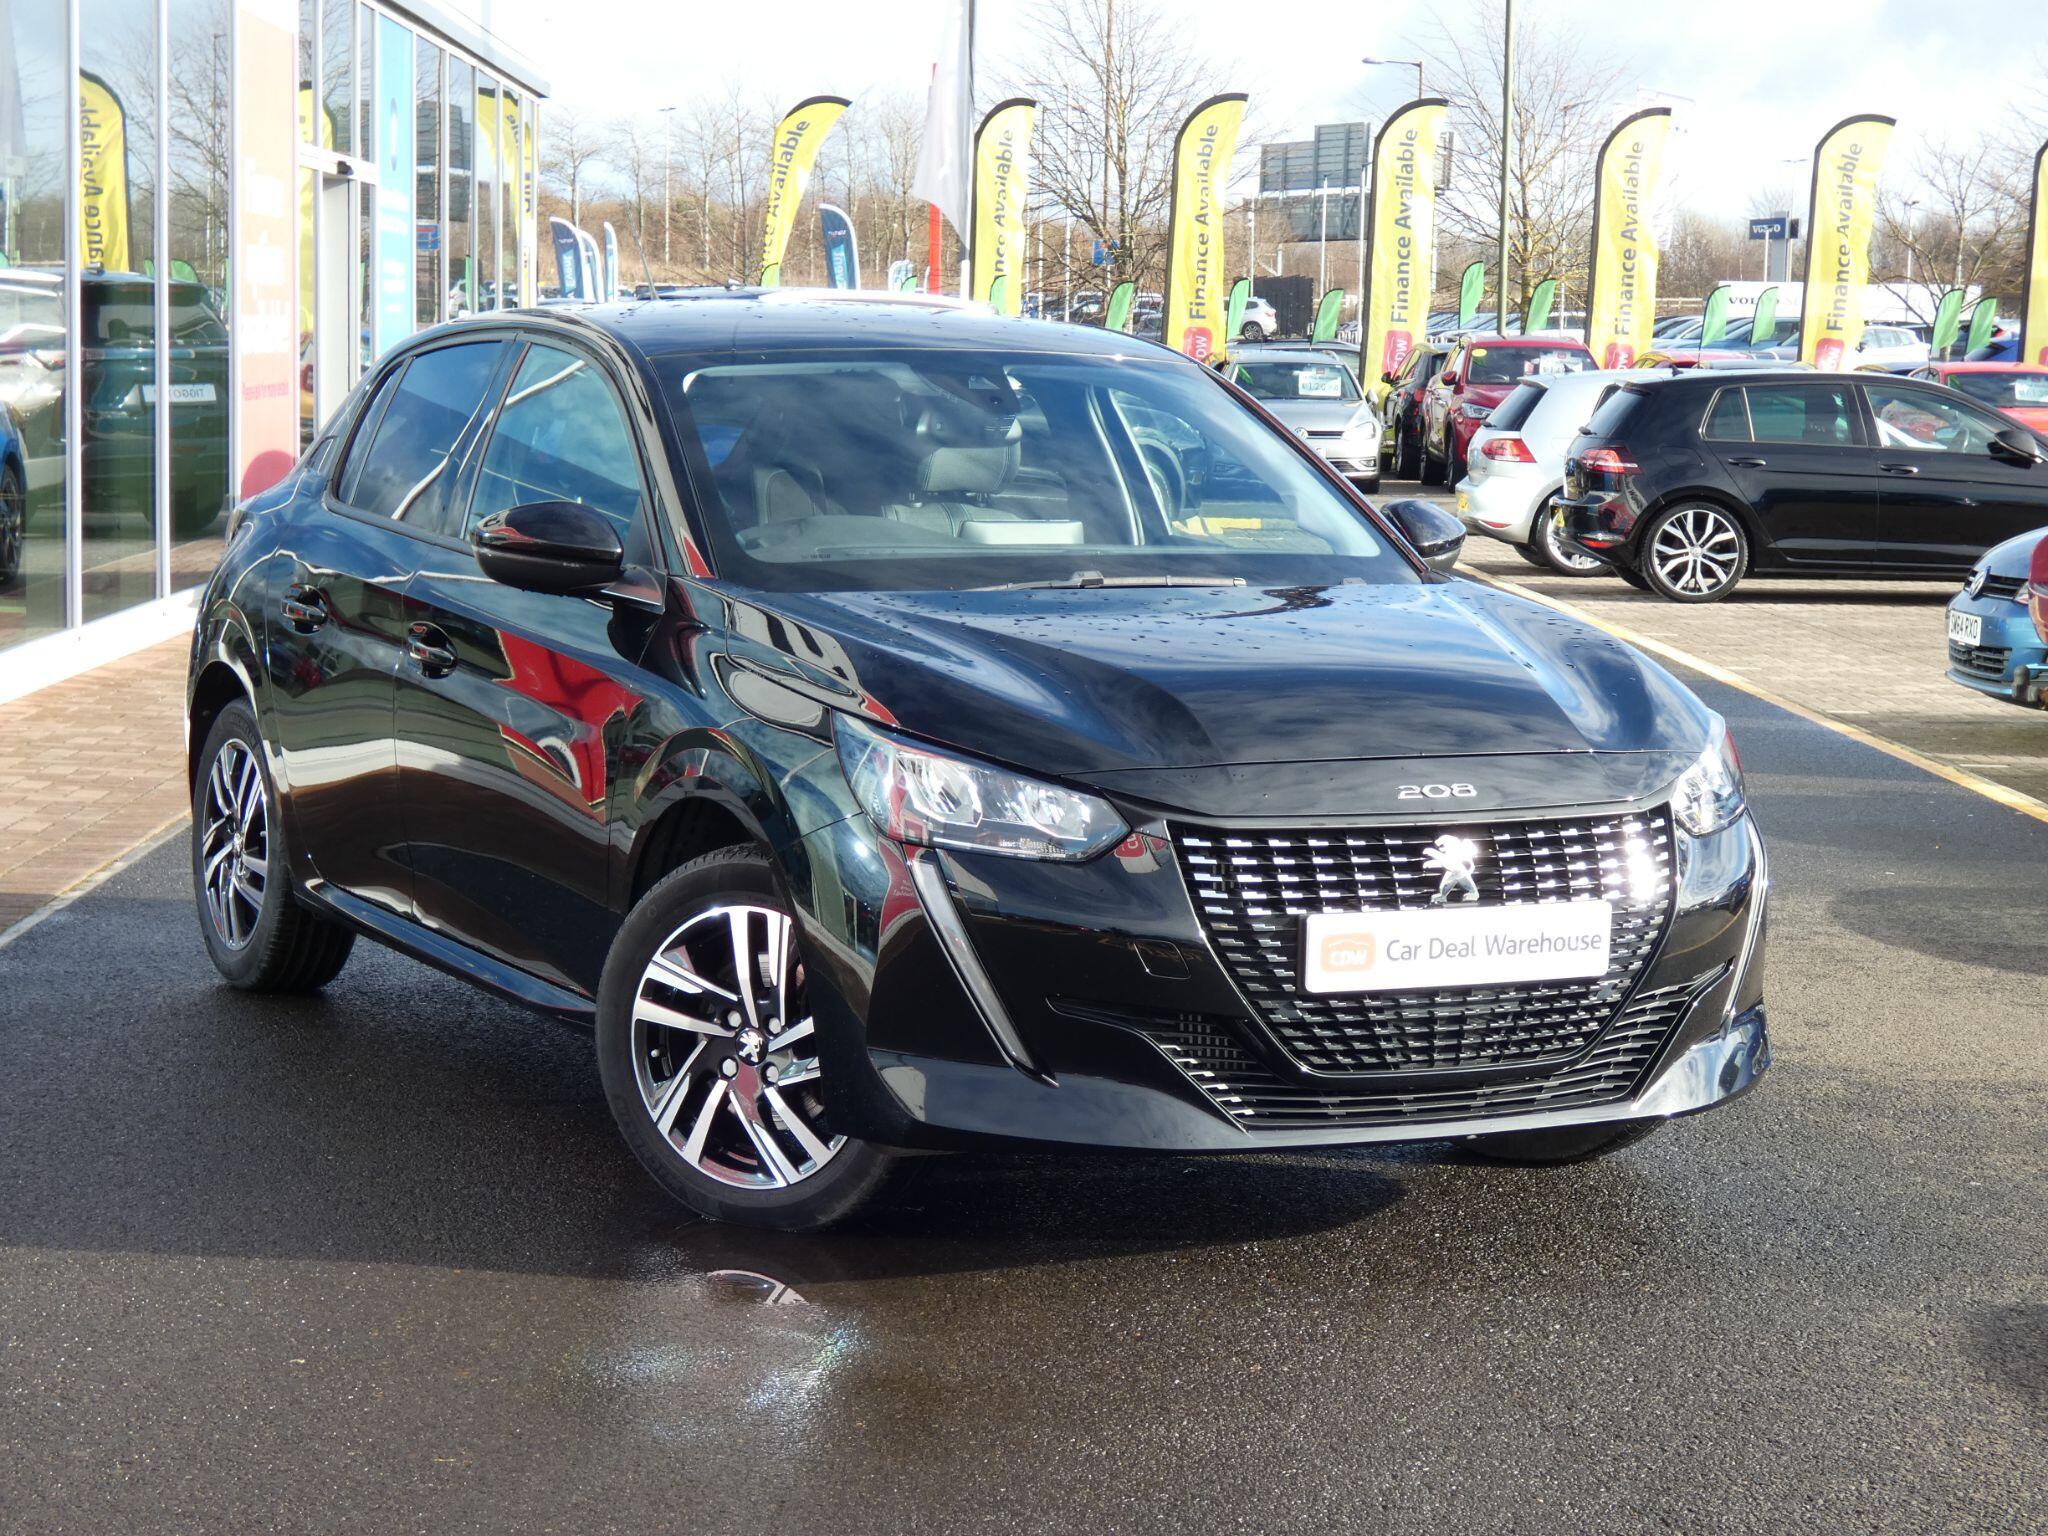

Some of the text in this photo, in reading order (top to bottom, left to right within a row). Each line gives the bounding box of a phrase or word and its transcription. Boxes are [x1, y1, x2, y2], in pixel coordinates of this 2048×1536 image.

[767, 120, 810, 218] Available
[994, 129, 1014, 227] Available
[1189, 124, 1219, 320] Finance Available
[1391, 128, 1418, 323] Finance Available
[1615, 141, 1645, 336] Finance Available
[1826, 142, 1863, 332] Finance Available
[1394, 783, 1478, 800] 208
[1386, 939, 1422, 961] Car
[1429, 935, 1476, 960] Deal
[1485, 932, 1602, 956] Warehouse
